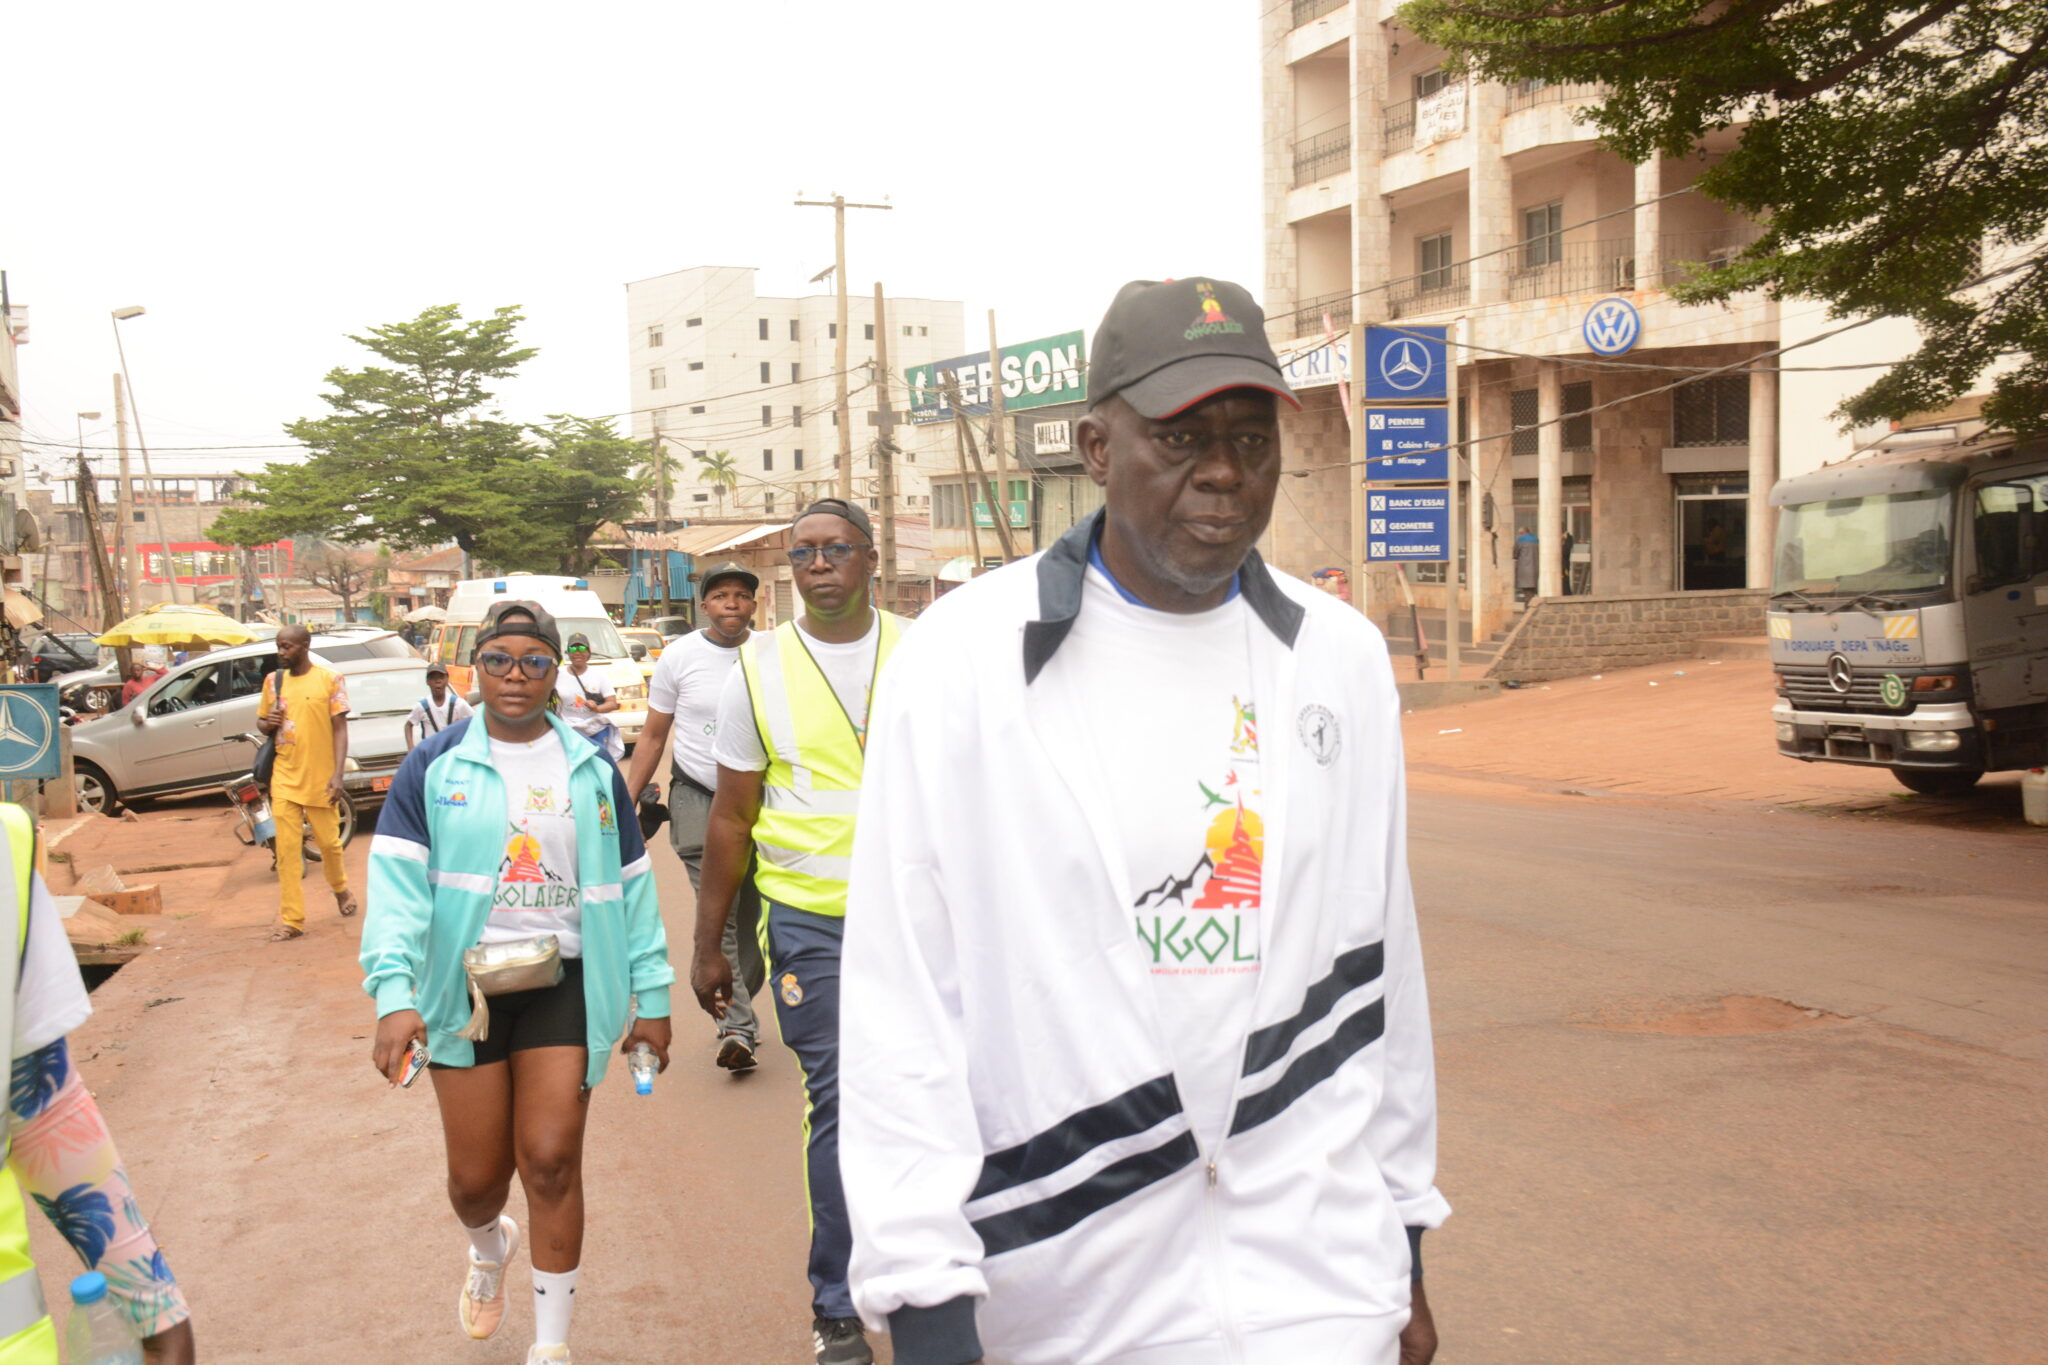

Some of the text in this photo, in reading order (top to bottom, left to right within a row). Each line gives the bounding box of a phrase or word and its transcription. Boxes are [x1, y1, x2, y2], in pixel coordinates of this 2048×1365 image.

[1388, 418, 1425, 426] PEINTURE
[1037, 423, 1066, 445] MILLA
[1397, 441, 1422, 449] Cabine
[1389, 498, 1445, 507] BANC D'ESSAI
[1389, 522, 1434, 530] GEOMETRIE
[1389, 545, 1441, 553] EQUILIBRAGE
[1887, 680, 1899, 700] G
[1136, 914, 1260, 964] NGOL
